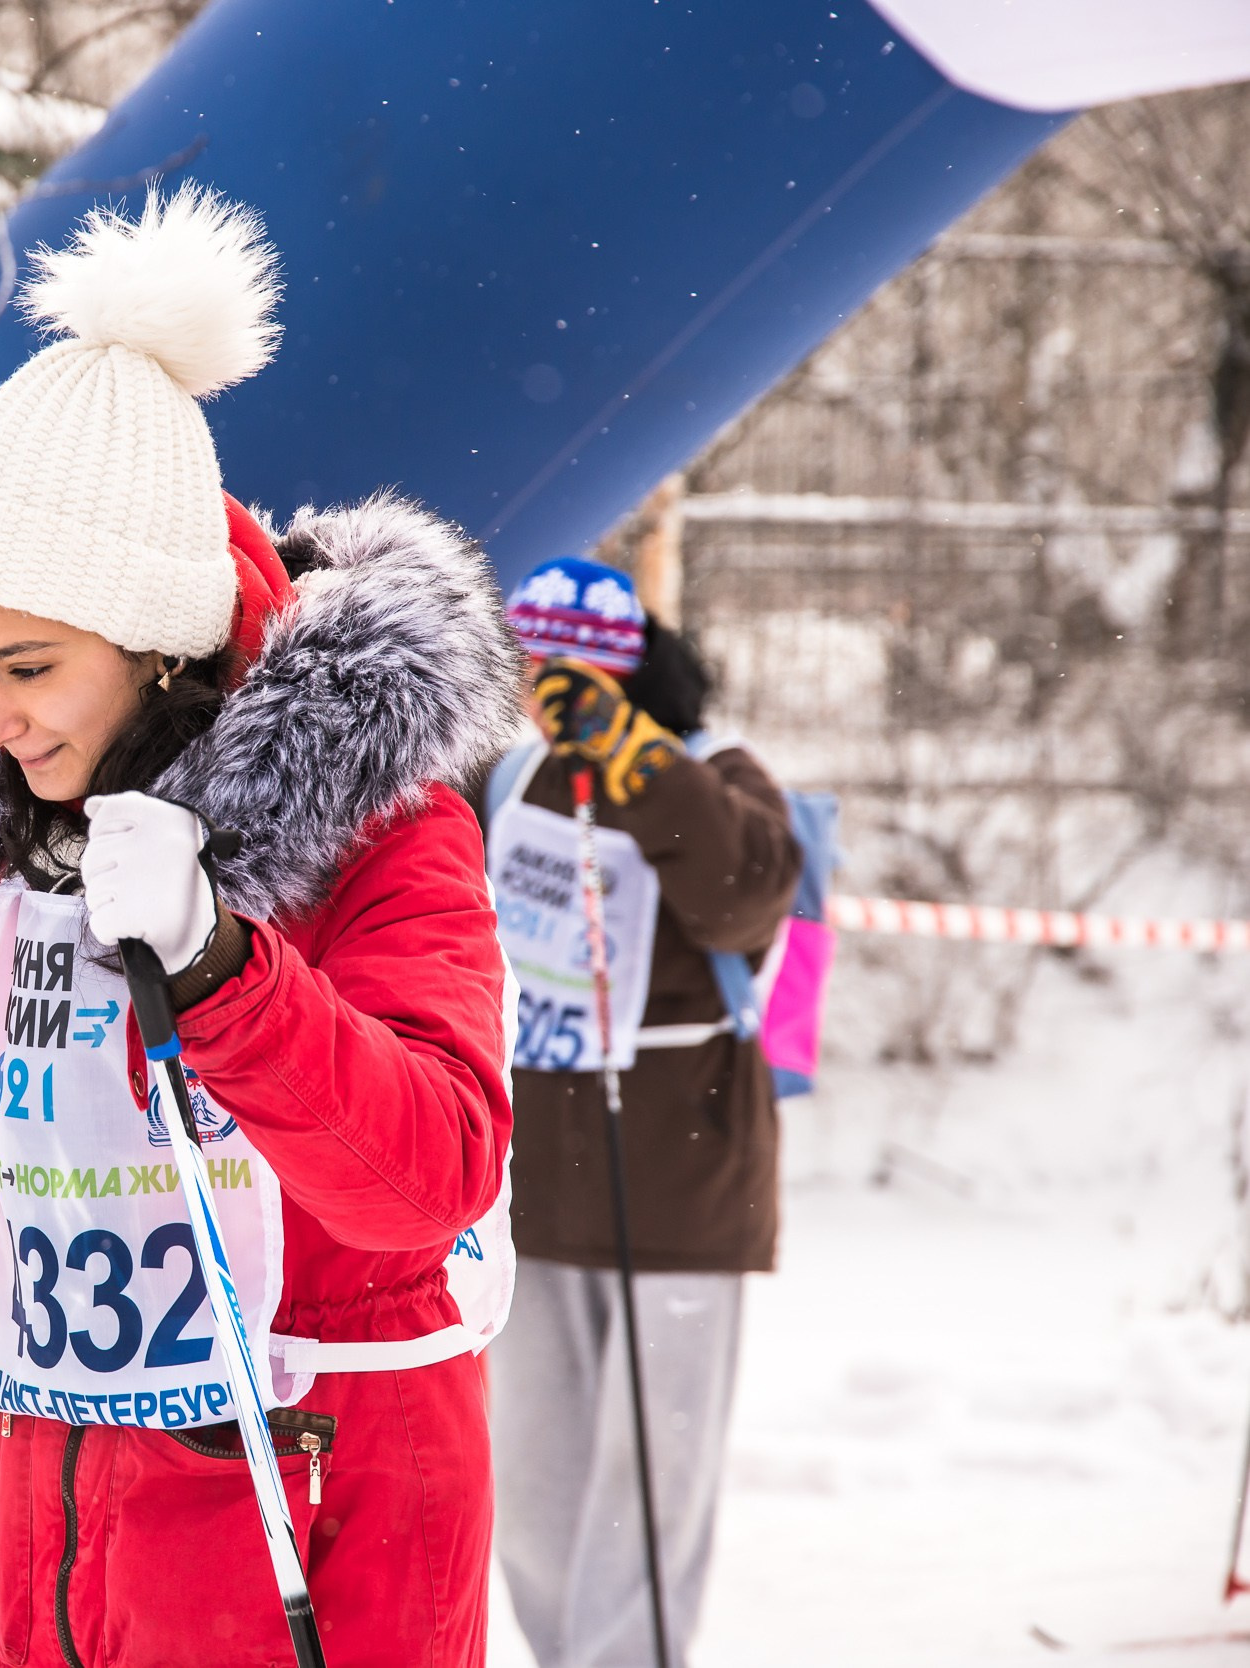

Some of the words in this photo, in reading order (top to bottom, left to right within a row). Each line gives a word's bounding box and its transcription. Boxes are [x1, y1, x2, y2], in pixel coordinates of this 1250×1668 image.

[15, 1163, 122, 1199] НОРМА
[128, 1158, 253, 1196] ЖИНИ
[6, 1218, 215, 1374] 332
